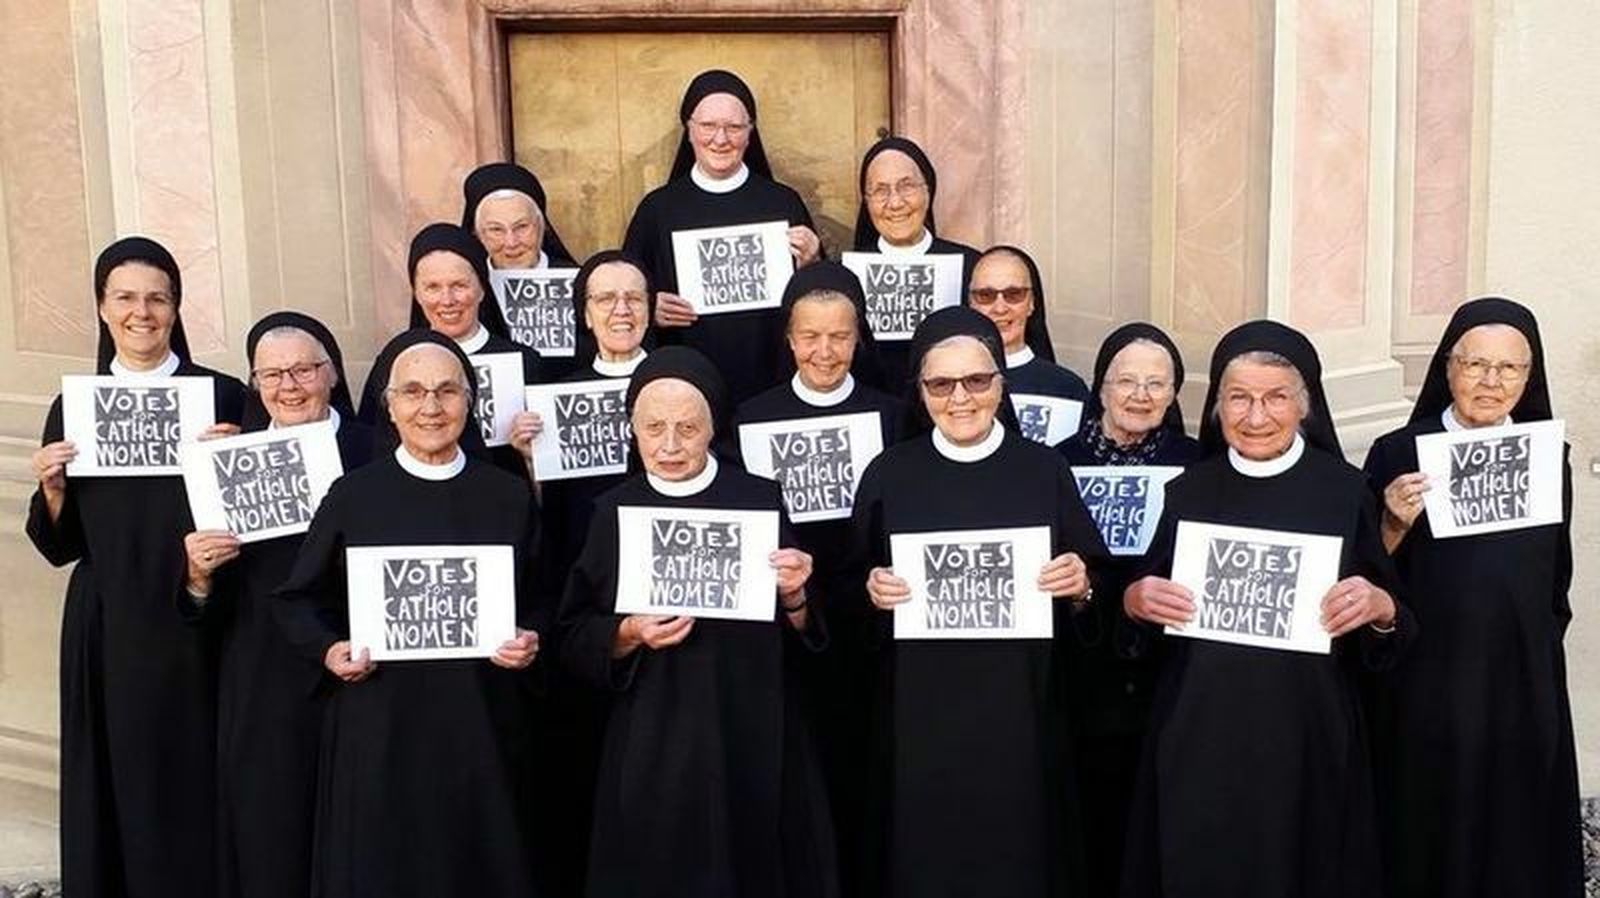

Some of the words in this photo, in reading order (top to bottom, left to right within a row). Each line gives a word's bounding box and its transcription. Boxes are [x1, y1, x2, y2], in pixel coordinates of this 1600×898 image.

[699, 235, 763, 261] VOTES
[701, 262, 766, 284] CATHOLIC
[867, 265, 933, 286] VOTES
[504, 279, 574, 300] VOTES
[703, 281, 768, 305] WOMEN
[866, 293, 933, 311] CATHOLIC
[503, 307, 576, 326] CATHOLIC
[511, 327, 576, 348] WOMEN
[96, 389, 178, 412] VOTES
[96, 421, 180, 441] CATHOLIC
[770, 429, 848, 459] VOTES
[96, 440, 180, 466] WOMEN
[212, 440, 301, 477] VOTES
[1450, 436, 1529, 469] VOTES
[220, 474, 310, 508] CATHOLIC
[1076, 477, 1149, 498] VOTES
[1450, 471, 1529, 500] CATHOLIC
[223, 499, 315, 535] WOMEN
[1088, 505, 1145, 525] THOLIC
[1451, 494, 1529, 525] WOMEN
[652, 520, 740, 547] VOTES
[651, 556, 740, 580] CATHOLIC
[925, 543, 1012, 570] VOTES
[1210, 541, 1301, 574] VOTES
[384, 559, 477, 588] VOTES
[651, 580, 738, 608] WOMEN
[926, 578, 1013, 601] CATHOLIC
[1203, 577, 1296, 609] CATHOLIC
[384, 596, 478, 620] CATHOLIC
[926, 600, 1014, 629] WOMEN
[1200, 602, 1293, 638] WOMEN
[385, 619, 478, 650] WOMEN
